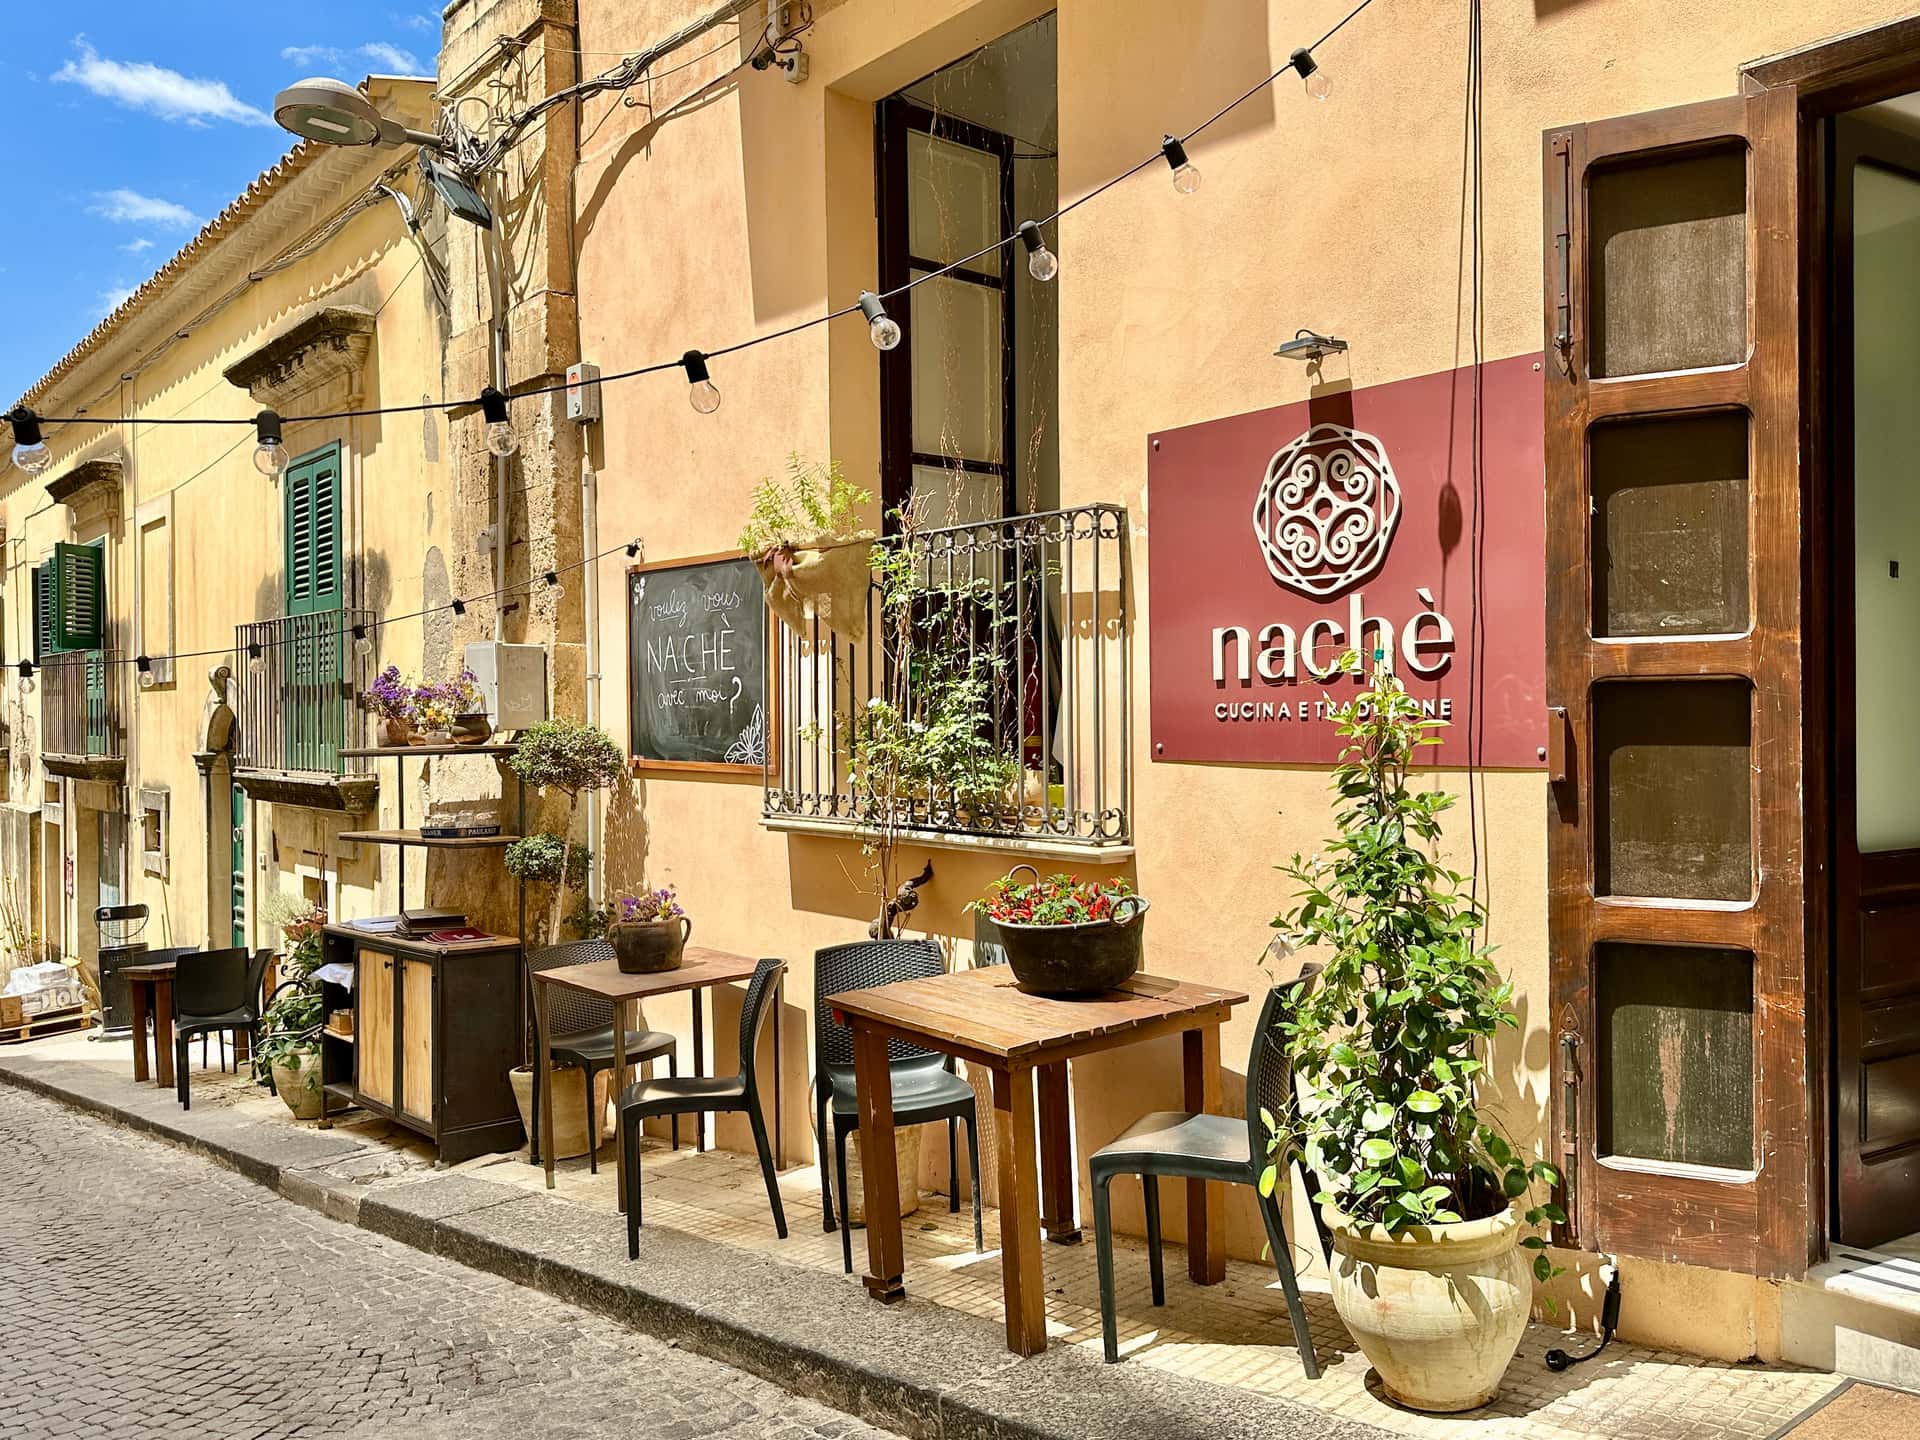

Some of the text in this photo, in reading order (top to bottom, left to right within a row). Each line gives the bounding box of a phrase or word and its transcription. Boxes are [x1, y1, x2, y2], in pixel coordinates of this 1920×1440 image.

[702, 591, 742, 610] vous
[647, 613, 735, 673] NACHÈ
[1212, 588, 1455, 681] nachè
[657, 688, 685, 709] avec
[1214, 698, 1453, 719] CUCINA E TRADIONE
